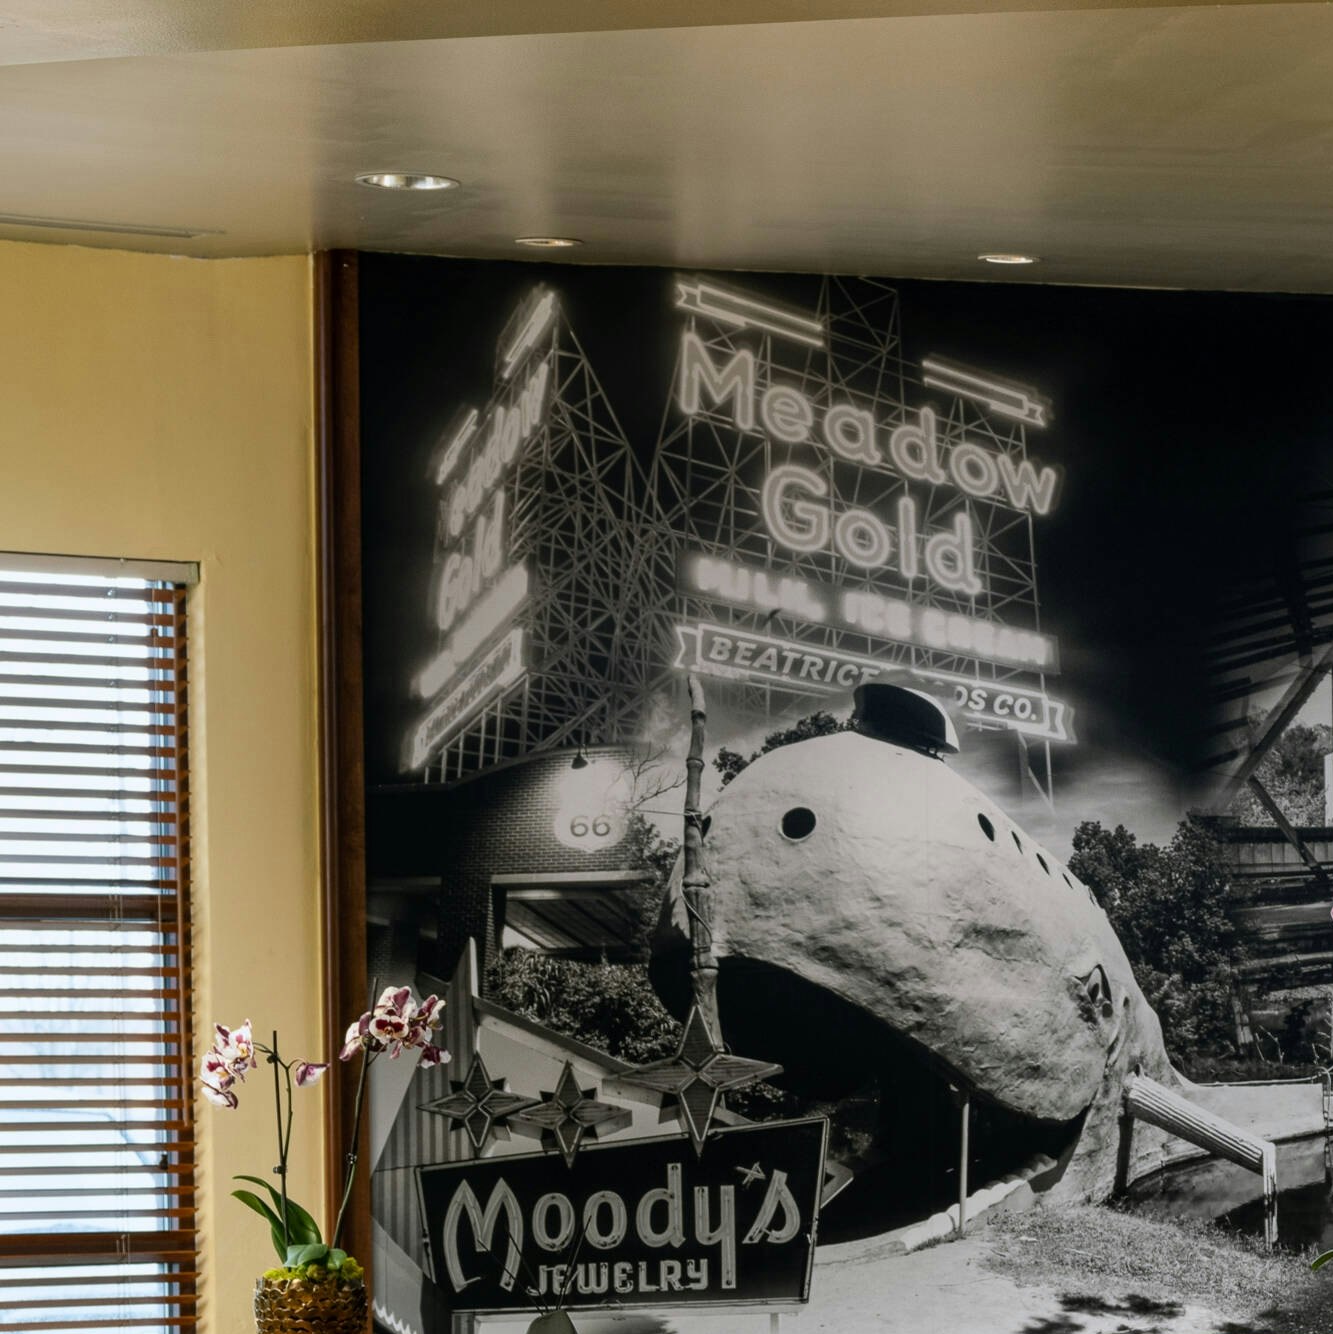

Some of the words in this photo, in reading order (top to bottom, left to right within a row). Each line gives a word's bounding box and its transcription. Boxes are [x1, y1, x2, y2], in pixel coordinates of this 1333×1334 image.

[678, 331, 1061, 515] Meadow
[761, 464, 982, 595] Gold
[709, 636, 880, 687] BEATRICE
[570, 814, 611, 837] 66
[443, 1162, 800, 1292] Moody's
[526, 1258, 708, 1296] JEWELRY
